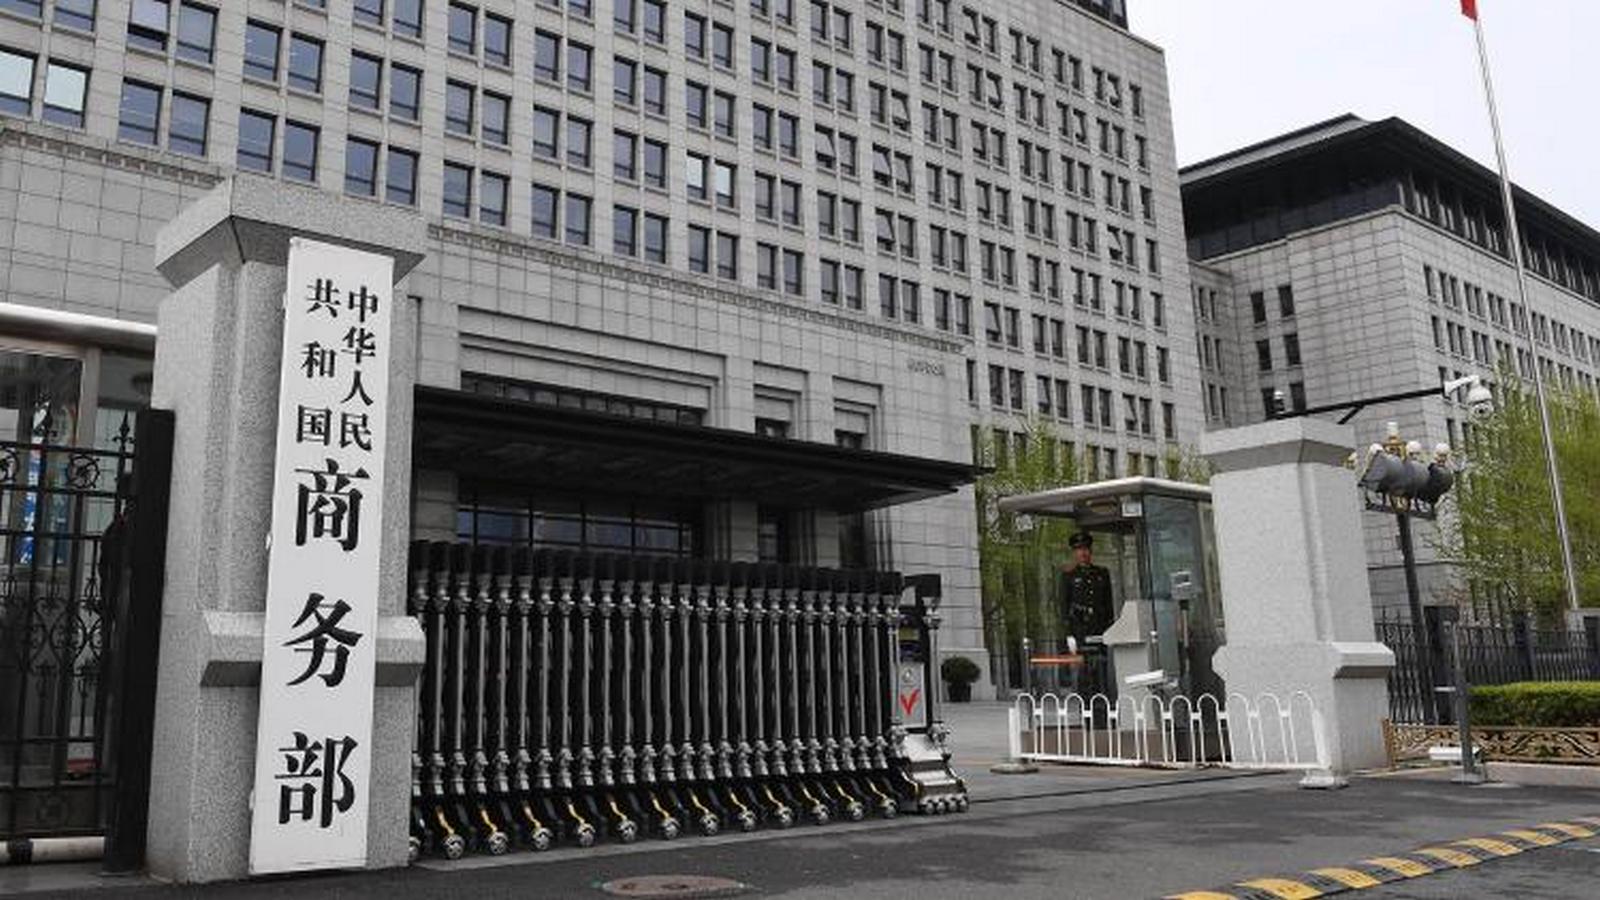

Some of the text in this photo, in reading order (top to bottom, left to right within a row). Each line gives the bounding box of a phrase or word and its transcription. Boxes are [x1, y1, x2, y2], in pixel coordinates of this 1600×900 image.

[296, 278, 341, 447] 共和国
[339, 285, 379, 452] 中华人民
[274, 458, 371, 829] 商务部
